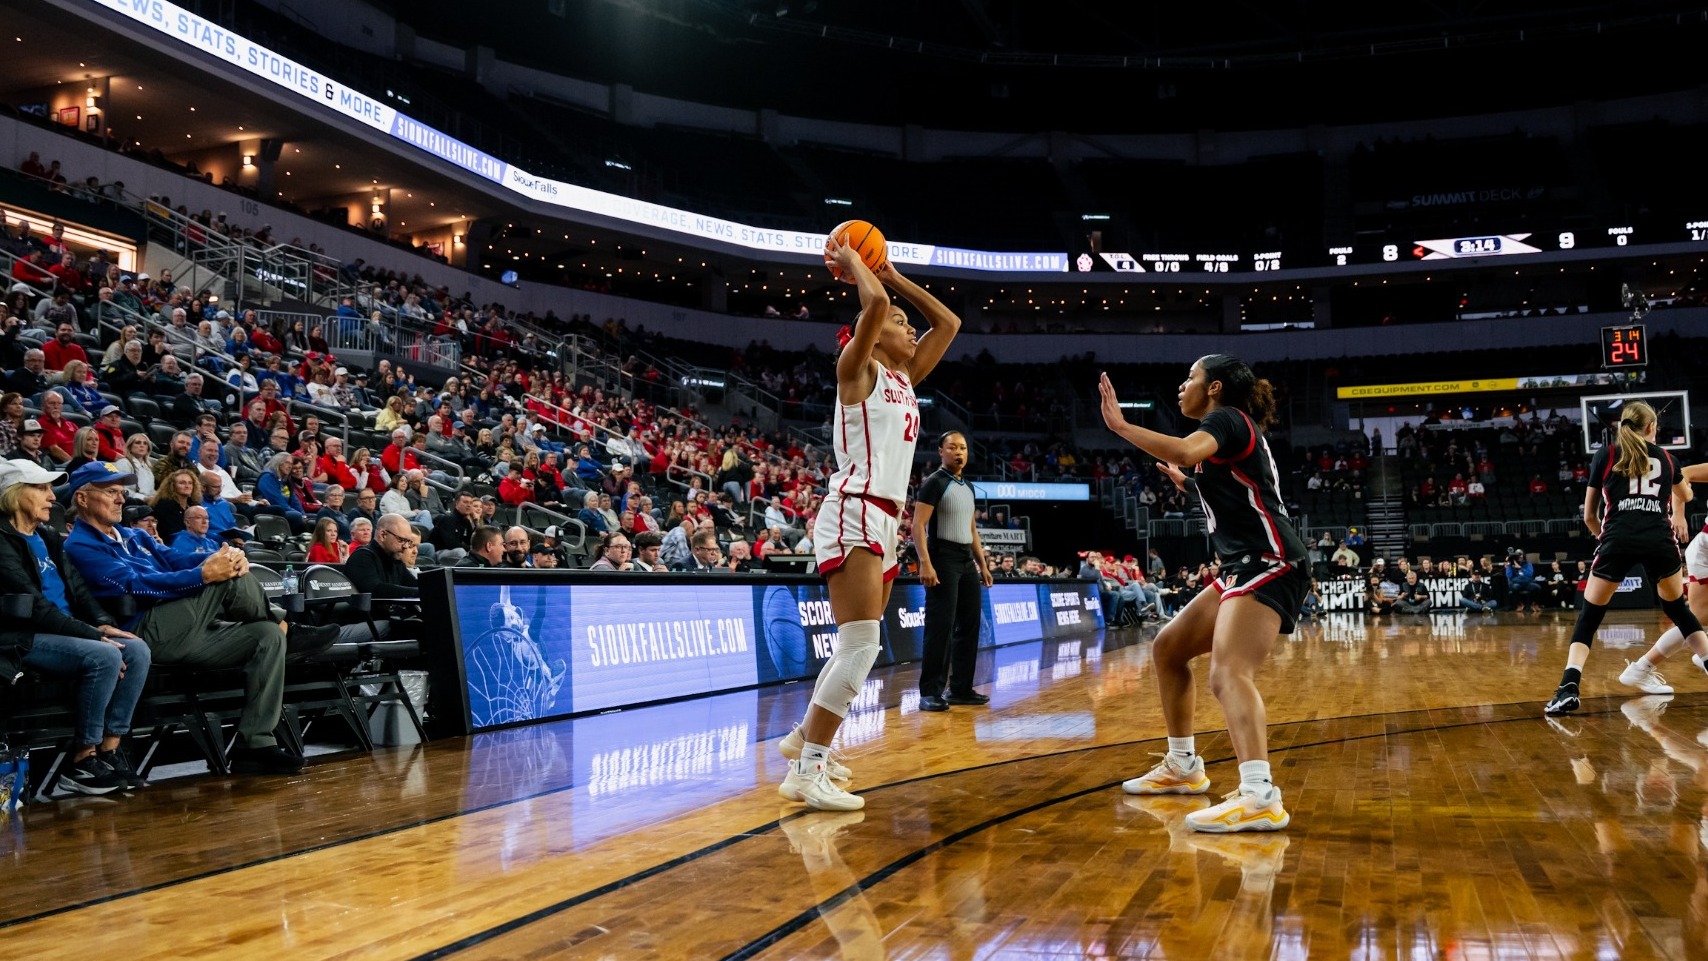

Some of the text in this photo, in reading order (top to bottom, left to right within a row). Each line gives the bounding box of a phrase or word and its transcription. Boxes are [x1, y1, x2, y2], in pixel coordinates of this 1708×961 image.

[177, 13, 241, 60] STATS,
[249, 46, 319, 94] STORIES
[325, 83, 335, 100] &
[340, 89, 386, 125] MORE.
[397, 117, 503, 184] SIOUXFALLSLIVE.COM
[1412, 191, 1475, 207] SUMMIT
[1479, 188, 1522, 201] DECK
[239, 199, 260, 217] 105
[695, 218, 738, 240] NEWS,
[741, 228, 789, 248] STATS,
[887, 245, 925, 260] ORE.
[1608, 227, 1634, 235] FOULS
[1559, 231, 1575, 249] 9
[1616, 235, 1628, 246] 0
[936, 249, 1060, 270] SIOUXFALLSLIVE.COM
[1329, 247, 1353, 255] FOULS
[1383, 244, 1399, 261] 8
[1154, 261, 1180, 272] 0/0
[1254, 259, 1281, 272] 0/2
[1337, 254, 1347, 266] 2
[1611, 342, 1639, 362] 24
[1351, 383, 1460, 396] CBEQUIPMENT.COM
[1017, 489, 1046, 498] MIDCO
[1617, 497, 1662, 513] MONCLOVA
[1003, 532, 1024, 541] MART
[798, 600, 836, 626] SCOR
[587, 618, 748, 667] SIOUXFALLSLIVE.COM
[812, 633, 839, 659] NEW
